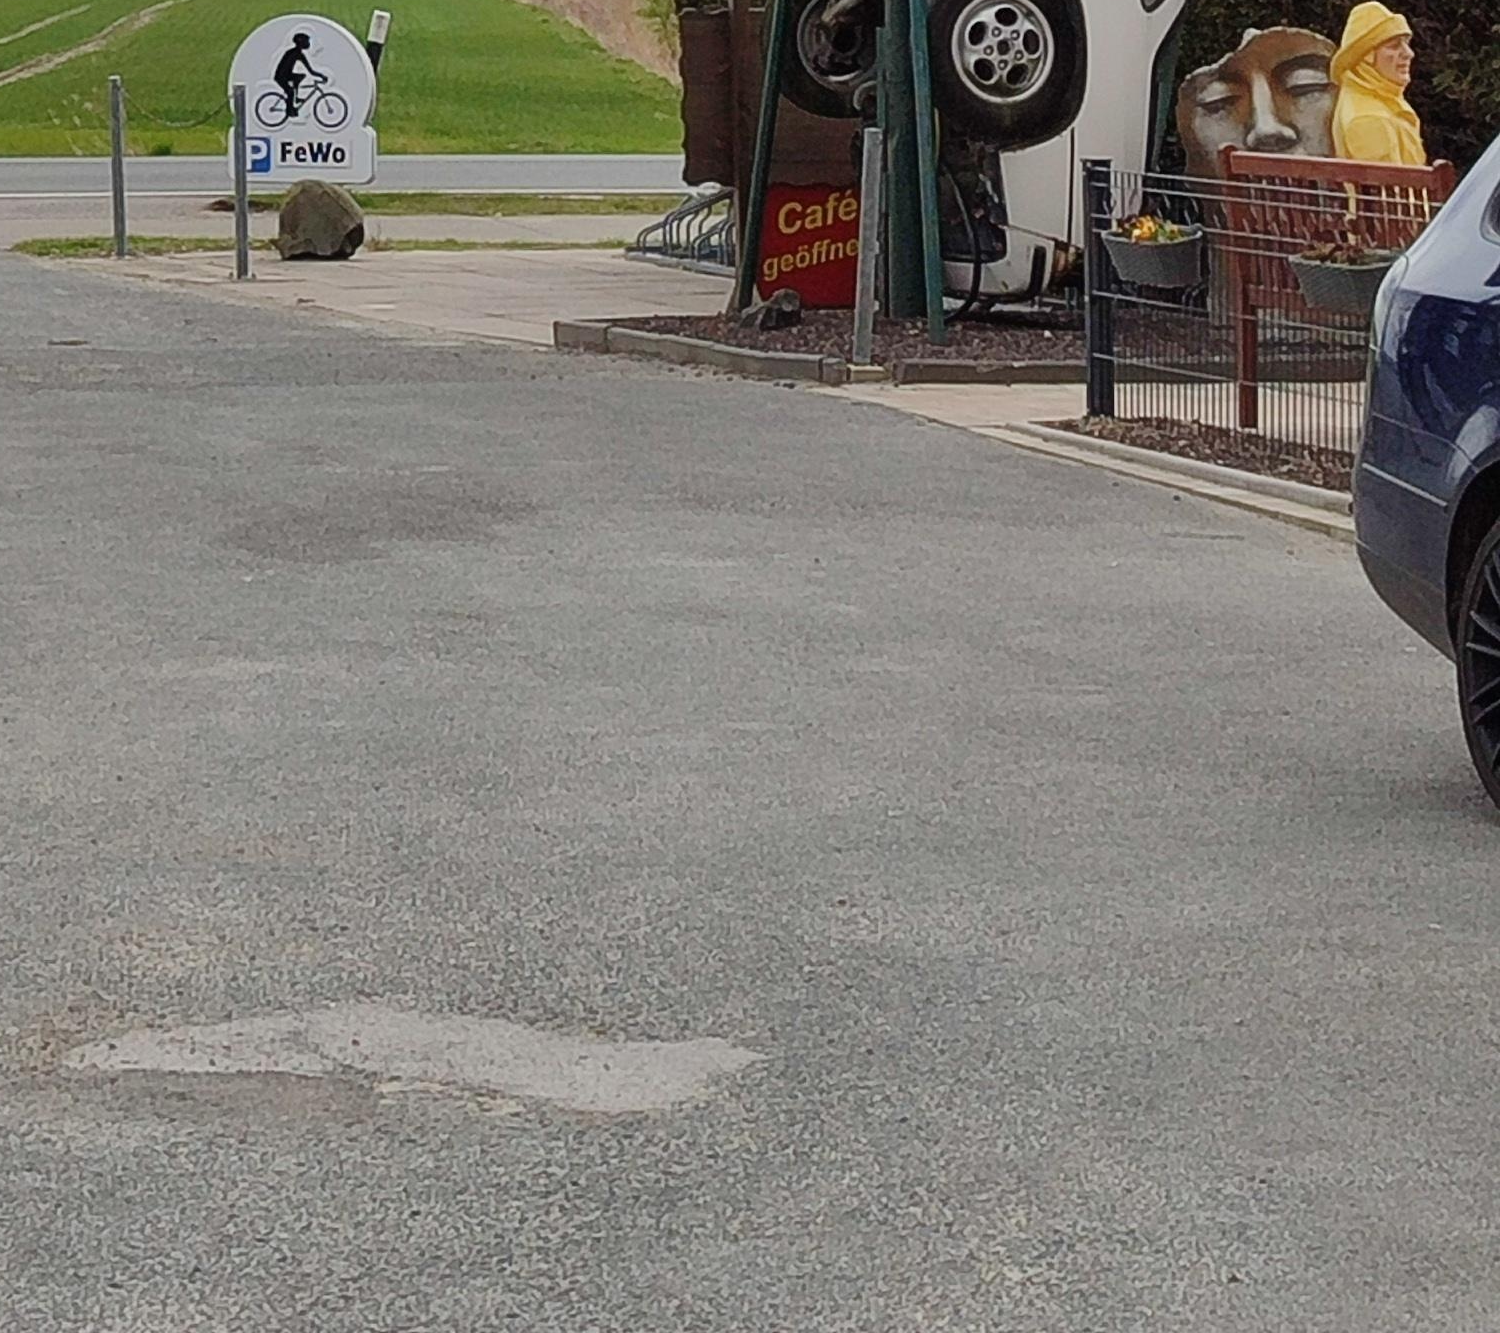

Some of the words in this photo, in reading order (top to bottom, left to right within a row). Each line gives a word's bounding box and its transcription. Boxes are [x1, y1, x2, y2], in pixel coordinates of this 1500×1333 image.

[279, 141, 346, 165] FeWo
[778, 189, 858, 235] Café
[762, 237, 860, 282] geöffne
